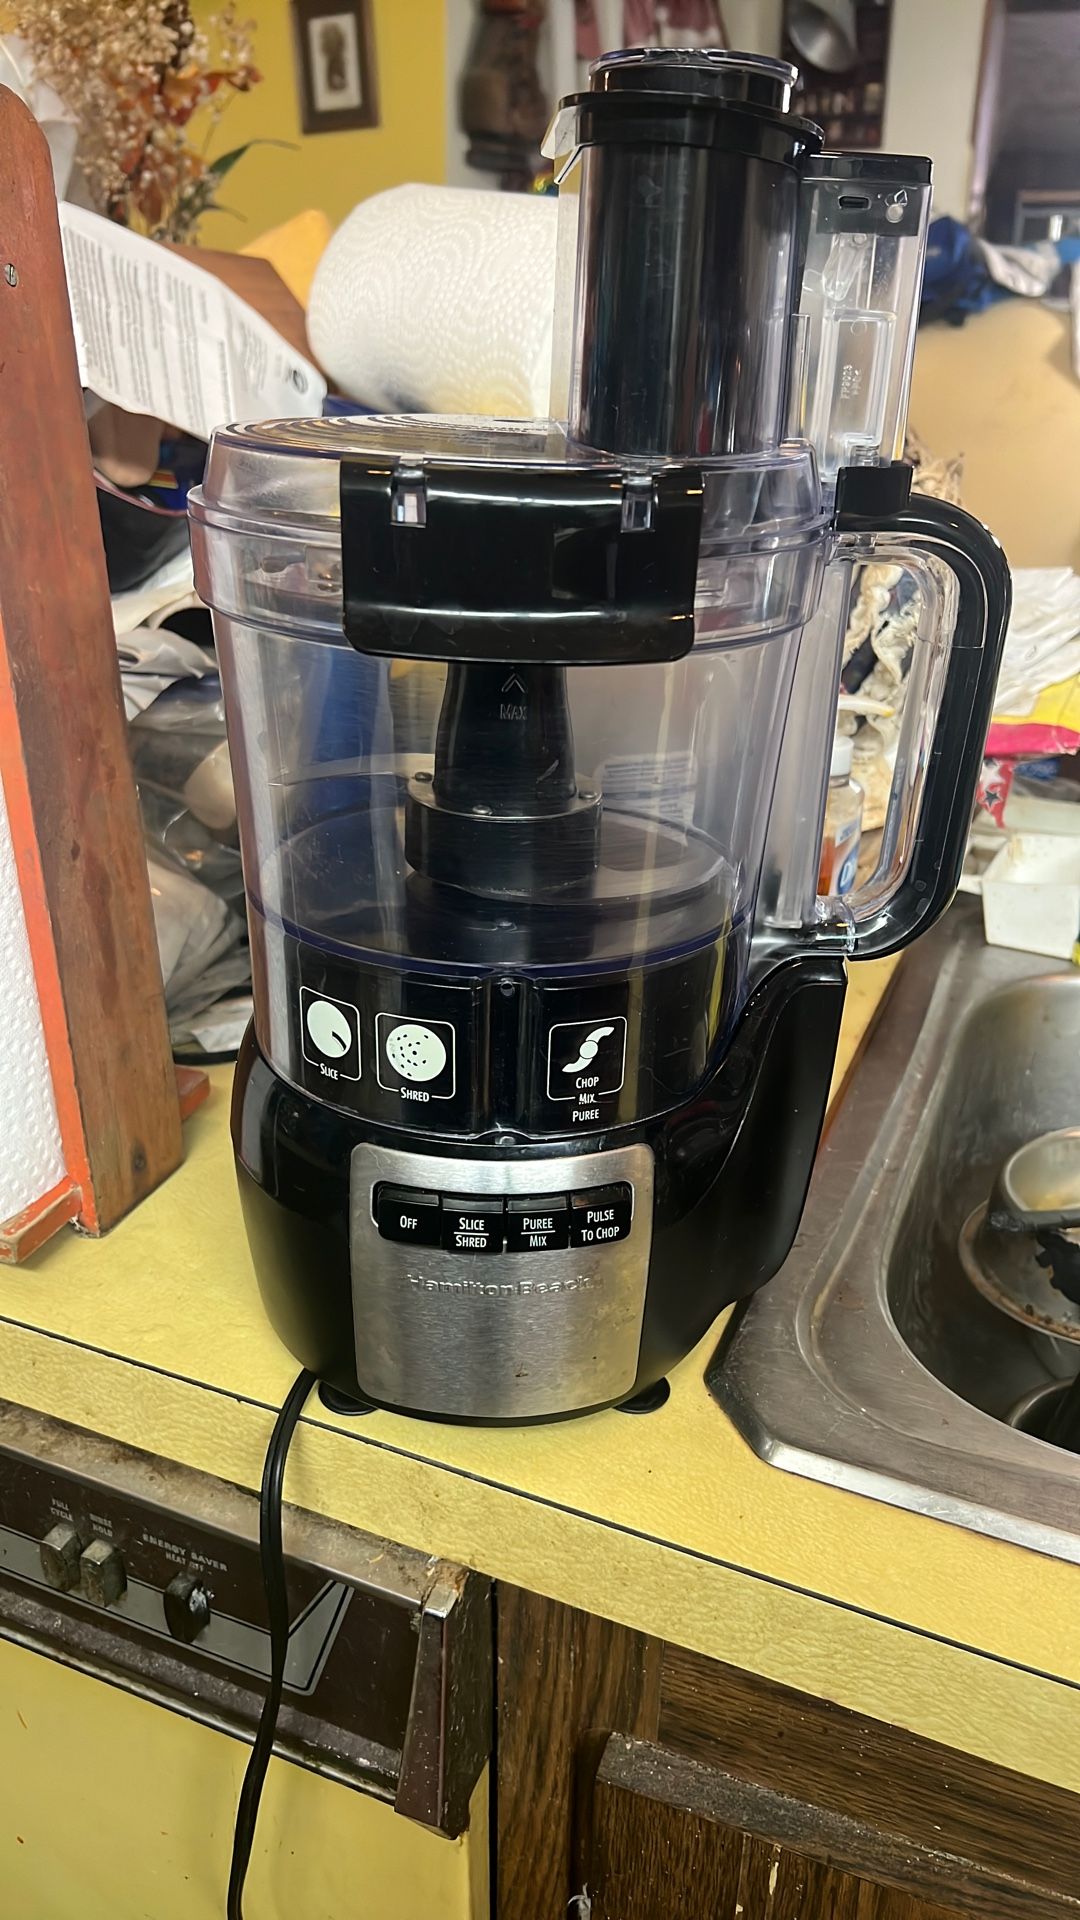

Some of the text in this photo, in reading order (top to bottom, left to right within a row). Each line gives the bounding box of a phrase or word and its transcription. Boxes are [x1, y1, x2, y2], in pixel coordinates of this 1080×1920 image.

[500, 703, 528, 720] MAX
[319, 1062, 339, 1081] SLICE
[575, 1076, 600, 1089] CHOP
[400, 1086, 430, 1103] SHRED
[578, 1092, 596, 1105] MIX
[572, 1108, 600, 1123] PUREE
[399, 1215, 418, 1230] OFF
[458, 1217, 485, 1231] SLICE
[522, 1217, 553, 1231] PUREE
[586, 1209, 615, 1224] PULSE
[455, 1234, 487, 1248] SHRED
[529, 1234, 547, 1247] MIX
[580, 1225, 621, 1242] TO CHOP
[405, 1273, 596, 1297] Hamilton Beach
[142, 1533, 228, 1572] ENERGY SAVER
